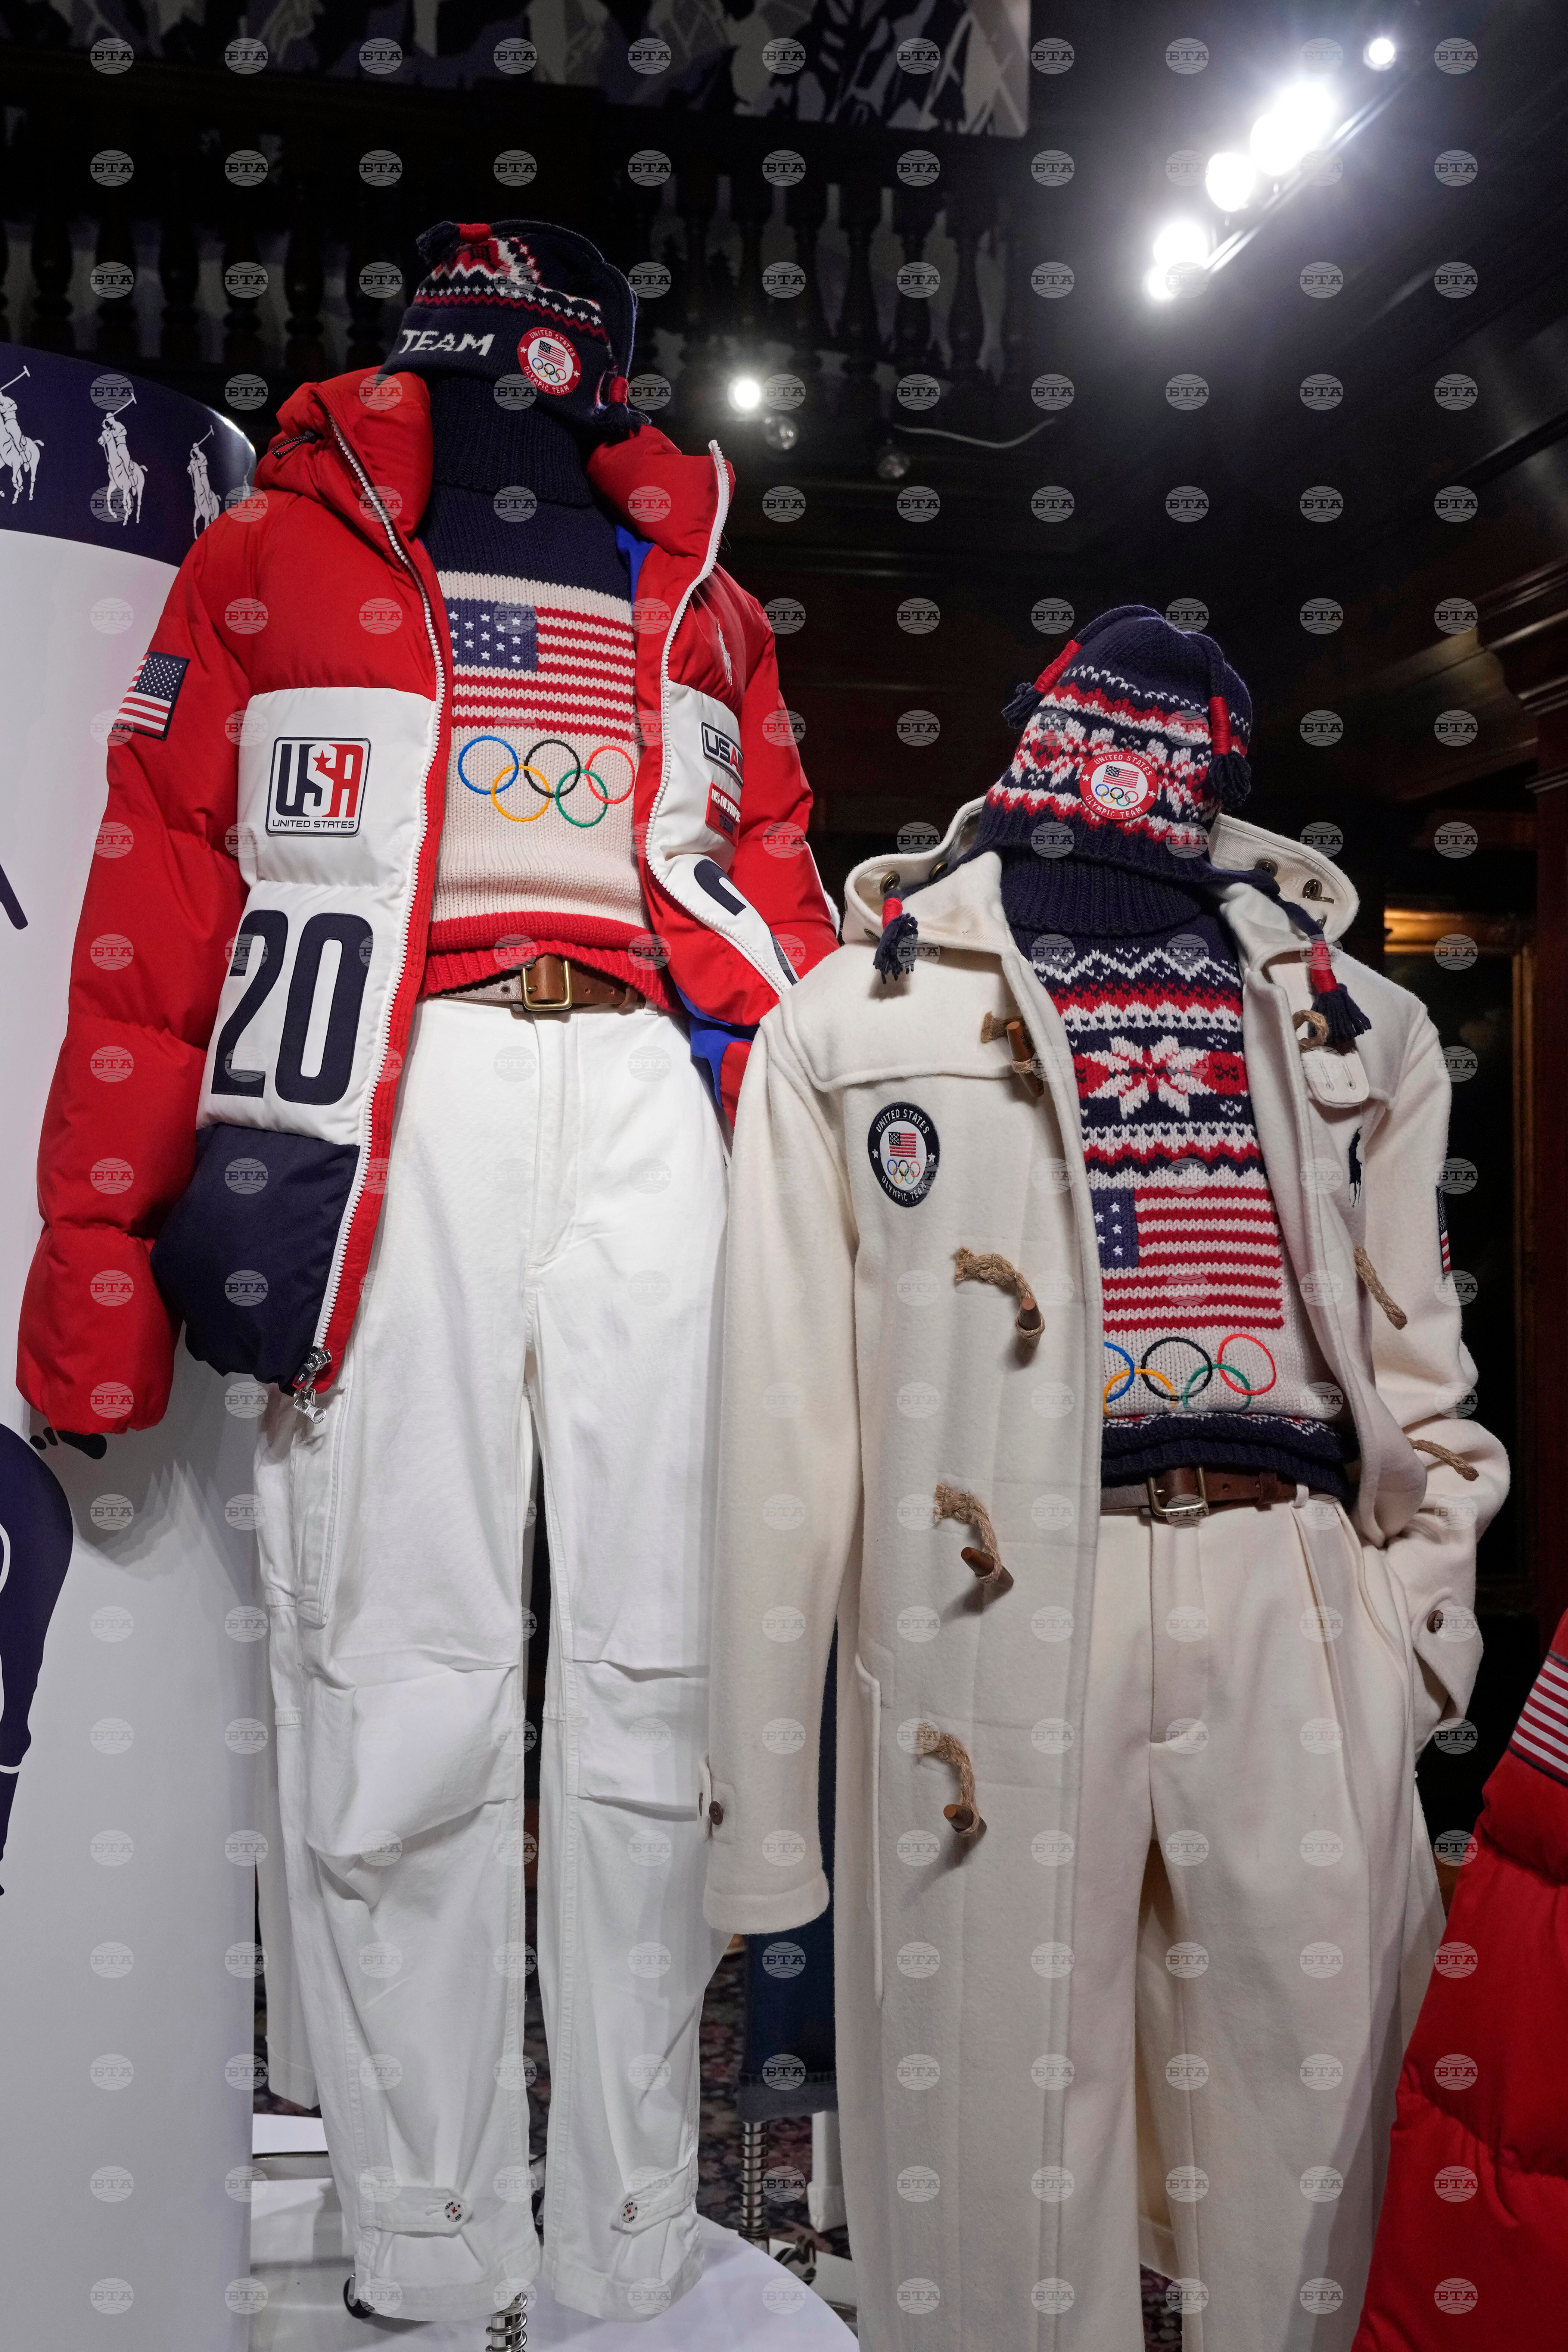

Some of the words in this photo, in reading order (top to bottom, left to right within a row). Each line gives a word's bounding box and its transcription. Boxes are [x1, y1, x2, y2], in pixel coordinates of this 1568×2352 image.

[398, 329, 495, 356] TEAM
[529, 330, 552, 339] UNITED
[555, 334, 576, 357] STATES
[524, 366, 549, 391] OLYMPIC
[552, 385, 569, 393] TEAM
[1094, 755, 1123, 765] UNITED
[1126, 756, 1152, 776] STATES
[276, 744, 364, 817] USA
[711, 788, 720, 805] US
[1085, 794, 1115, 817] OLYMPIC
[1120, 806, 1143, 818] TEAM
[211, 909, 373, 1105] 20
[876, 1109, 900, 1133] UNITED
[903, 1109, 930, 1134] STATES
[881, 1176, 908, 1202] OLYMPIC
[910, 1181, 927, 1200] TEAM
[445, 2202, 454, 2210] TEAM
